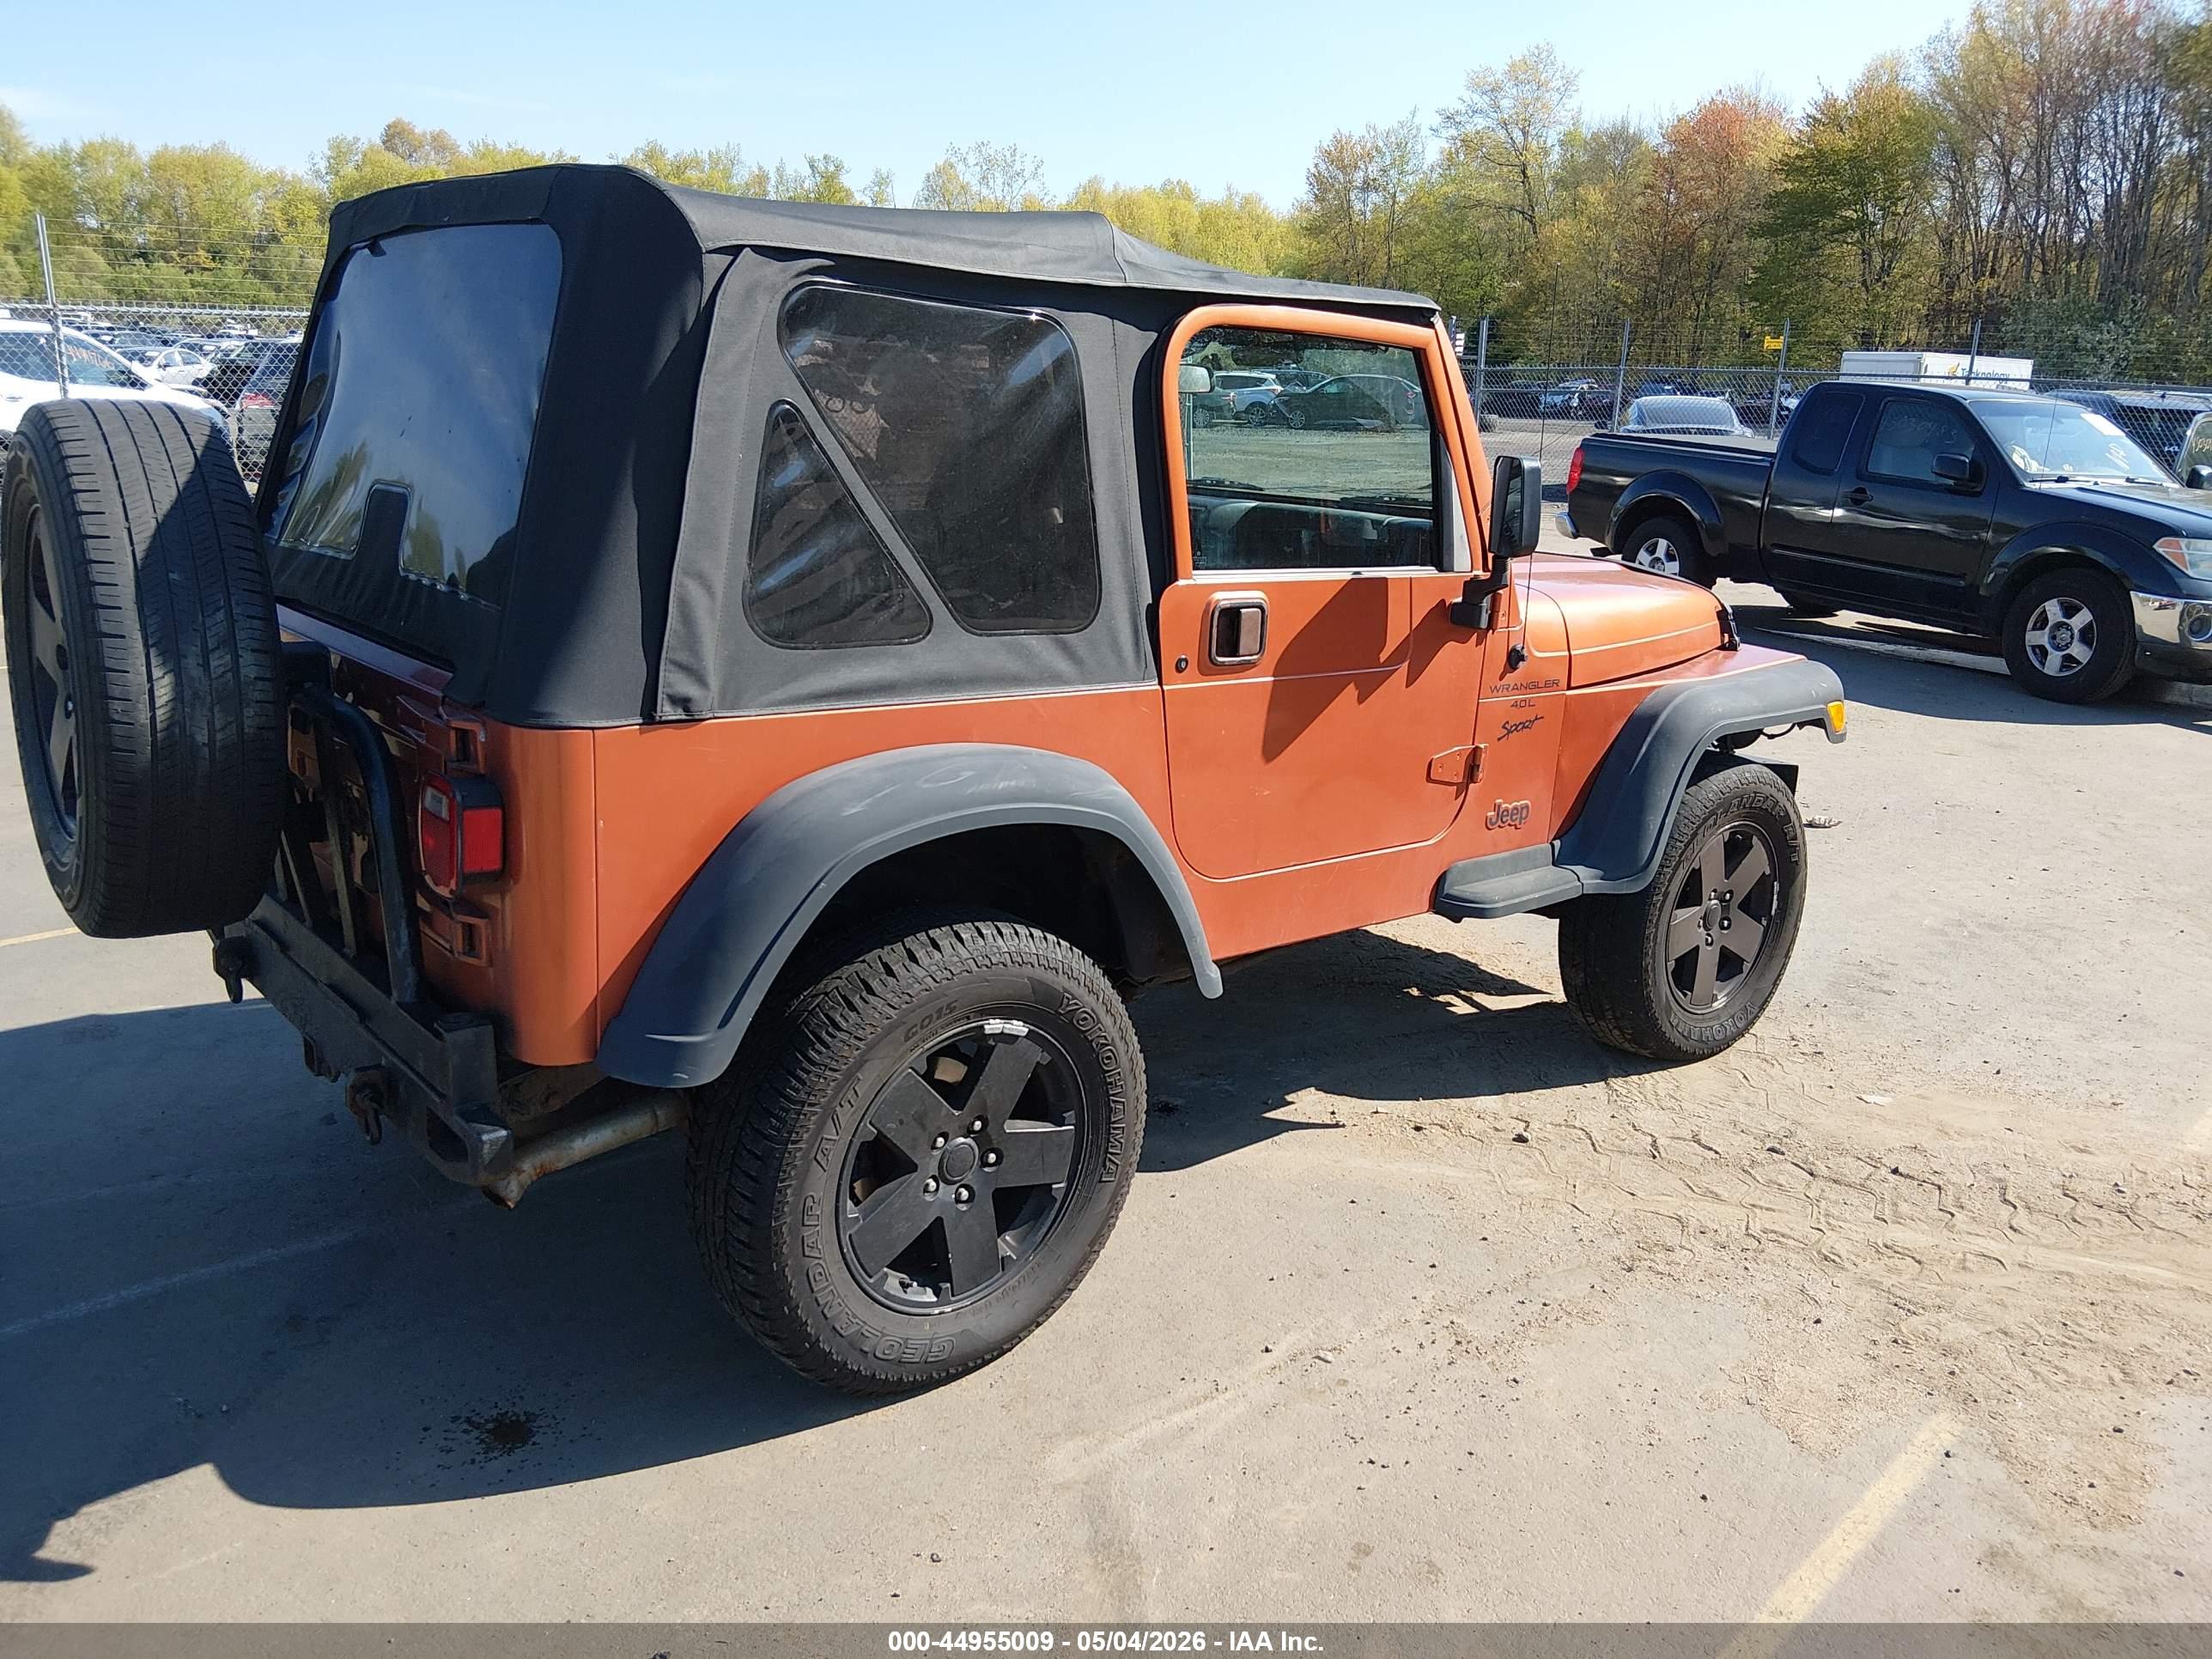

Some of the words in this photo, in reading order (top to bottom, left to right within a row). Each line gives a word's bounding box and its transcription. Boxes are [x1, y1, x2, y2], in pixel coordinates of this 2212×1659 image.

[1490, 678, 1560, 694] WRANGLER
[1486, 799, 1531, 830] Jeep
[813, 1073, 864, 1173] A/T
[1055, 991, 1127, 1184] YOKOHAMA
[802, 1192, 956, 1364] GEOLANDAR
